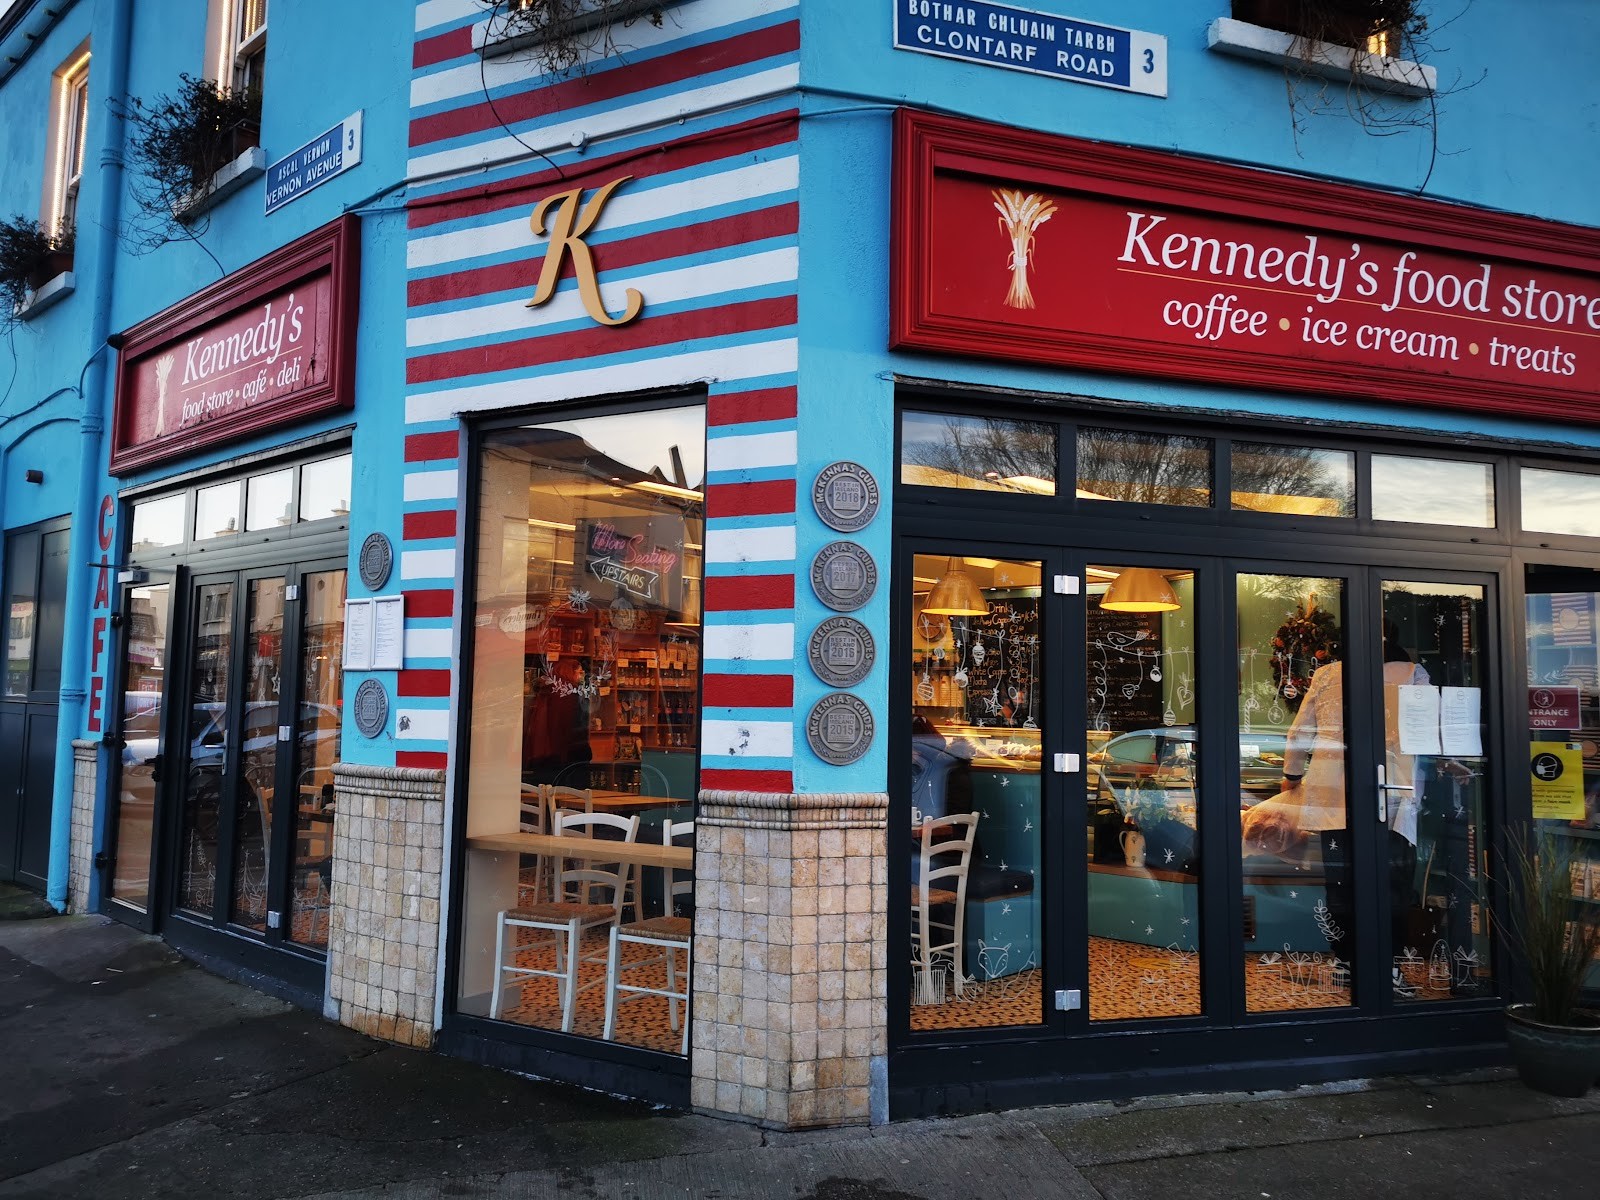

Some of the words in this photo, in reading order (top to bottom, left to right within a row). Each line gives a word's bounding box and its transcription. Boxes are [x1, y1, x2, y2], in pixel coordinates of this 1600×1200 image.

[908, 0, 976, 26] BOTHAR
[988, 12, 1055, 42] CHLUAIN
[1065, 27, 1115, 53] TARBH
[917, 25, 1037, 62] CLONTARF
[1056, 50, 1115, 77] ROAD
[1142, 48, 1155, 74] 3
[348, 129, 354, 150] 3
[266, 175, 302, 206] VERNON
[306, 151, 342, 183] AVENUE
[278, 159, 298, 182] ASCAL
[303, 139, 331, 166] VERNON
[525, 174, 644, 326] K
[1117, 211, 1379, 303] Kennedy's
[1381, 251, 1492, 313] food
[181, 293, 304, 385] Kennedy's
[1162, 293, 1268, 341] coffee
[1301, 306, 1348, 346] ice
[1356, 323, 1460, 360] cream
[1489, 336, 1576, 376] treats
[179, 392, 206, 427] food
[206, 388, 234, 412] store
[242, 368, 267, 402] café
[277, 356, 302, 387] deli
[835, 493, 859, 502] 2018
[858, 469, 878, 505] GUIDES
[620, 534, 678, 573] Seating
[857, 550, 876, 584] GUIDES
[601, 564, 645, 588] UPSTAIRS
[834, 572, 856, 582] 2017
[87, 494, 115, 732] CAFE
[855, 624, 874, 660] GUIDES
[854, 701, 873, 737] GUIDES
[1529, 708, 1569, 717] NTRANCE
[1533, 719, 1557, 727] ONLY
